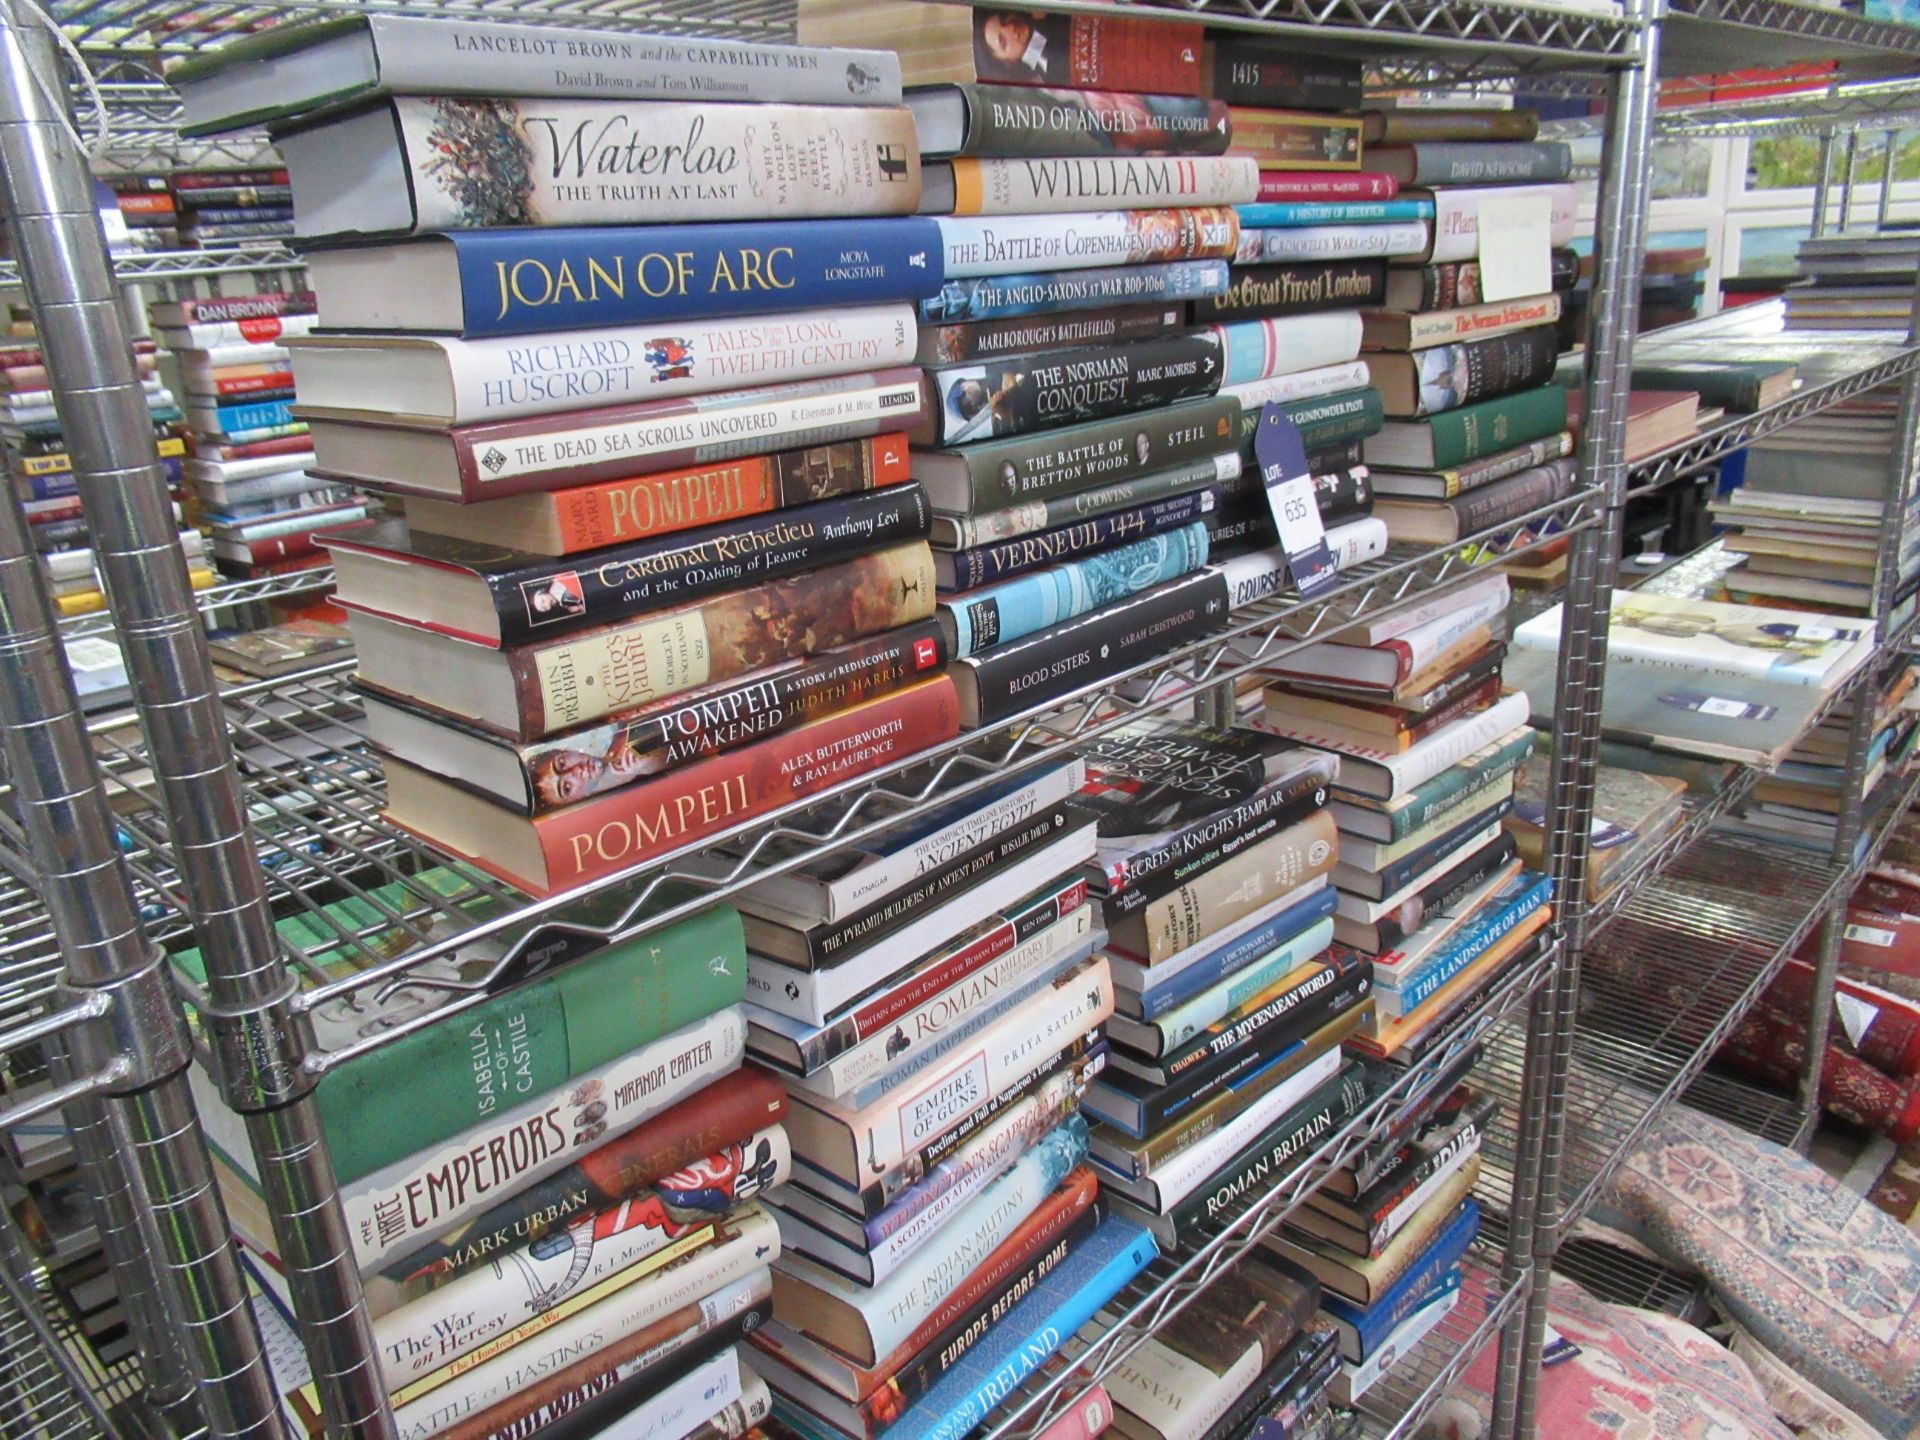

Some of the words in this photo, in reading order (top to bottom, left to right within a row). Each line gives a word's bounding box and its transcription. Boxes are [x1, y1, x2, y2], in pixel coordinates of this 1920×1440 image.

[454, 34, 557, 57] LANCELOT
[567, 41, 632, 60] BROWN
[640, 47, 662, 61] and
[665, 47, 682, 62] the
[688, 49, 781, 68] CAPABILITY
[785, 54, 818, 69] MEN
[555, 71, 590, 87] David
[593, 72, 633, 89] Brown
[636, 75, 656, 89] and
[660, 76, 685, 91] Tom
[688, 76, 748, 93] Williamson
[993, 104, 1045, 129] BAND
[1050, 107, 1071, 130] OF
[1077, 107, 1137, 133] ANGELS
[1145, 114, 1168, 130] KATE
[1171, 115, 1209, 133] COOPER
[521, 115, 739, 178] Waterloo
[1026, 159, 1172, 198] WILLIAM
[1178, 163, 1197, 194] II
[1451, 162, 1485, 176] DAVID
[1488, 162, 1533, 176] NEWSOME
[554, 185, 592, 200] THE
[598, 185, 662, 200] TRUTH
[667, 185, 693, 199] AT
[697, 184, 738, 199] LAST
[840, 251, 869, 264] MOYA
[951, 244, 978, 264] THE
[983, 230, 1042, 261] BATTLE
[1045, 242, 1060, 257] OF
[1065, 229, 1145, 256] COPENHAGEN
[495, 256, 626, 320] JOAN
[637, 252, 694, 298] OF
[709, 247, 795, 291] ARC
[825, 265, 885, 280] LONGSTAFFE
[980, 289, 1002, 307] THE
[1006, 281, 1087, 304] ANGLO-SAXONS
[1089, 284, 1098, 297] AT
[1101, 280, 1122, 295] WAR
[1125, 276, 1164, 295] 800-1066
[197, 302, 228, 322] DAN
[229, 301, 279, 321] BROWN
[702, 328, 761, 352] TALES
[785, 321, 842, 344] LONG
[895, 319, 903, 346] Yale
[510, 340, 630, 374] RICHARD
[707, 350, 796, 377] TWELFTH
[801, 338, 882, 366] CENTURY
[1032, 369, 1062, 387] THE
[1067, 357, 1129, 381] NORMAN
[1137, 369, 1163, 383] MARC
[1165, 361, 1196, 379] MORRIS
[483, 367, 634, 407] HUSCROFT
[879, 392, 914, 407] ELEMENT
[1037, 379, 1129, 414] CONQUEST
[516, 447, 546, 465] THE
[555, 439, 597, 460] DEAD
[605, 435, 631, 455] SEA
[638, 426, 694, 449] SCROLLS
[700, 413, 777, 439] UNCOVERED
[1026, 456, 1052, 471] THE
[1058, 444, 1104, 465] BATTLE
[1109, 438, 1124, 452] OF
[1168, 426, 1205, 446] STEIL
[1022, 467, 1081, 490] BRETTON
[1087, 456, 1129, 475] WOODS
[607, 467, 746, 537] POMPEII
[1284, 498, 1307, 522] 635
[823, 514, 874, 542] Anthony
[879, 509, 899, 531] Levi
[990, 522, 1106, 573] VERNEUIL
[1110, 512, 1146, 538] 1424
[599, 543, 709, 588] Cardinal
[716, 523, 814, 562] Richelieu
[623, 584, 649, 602] and
[655, 577, 679, 595] the
[685, 564, 741, 586] Making
[747, 556, 760, 572] of
[766, 547, 808, 570] France
[1120, 629, 1147, 648] SARAH
[1149, 609, 1195, 636] GRISTWOOD
[786, 683, 792, 692] A
[795, 672, 826, 690] STORY
[828, 667, 837, 679] of
[839, 648, 900, 674] REDISCOVERY
[1010, 668, 1048, 695] BLOOD
[1051, 650, 1090, 677] SISTERS
[659, 680, 780, 742] POMPEII
[666, 709, 782, 762] AWAKENED
[781, 751, 812, 774] ALEX
[817, 718, 903, 760] BUTTERWORTH
[792, 774, 802, 786] &
[805, 764, 829, 784] RAY
[833, 740, 894, 772] LAURENCE
[569, 775, 749, 874] POMPEII
[1236, 790, 1284, 826] TEMPLAR
[1170, 848, 1182, 860] THE
[1172, 840, 1180, 850] OF
[1182, 819, 1234, 854] KNIGHTS
[1123, 850, 1170, 882] SECRETS
[822, 935, 843, 952] THE
[844, 912, 882, 946] PYRAMID
[884, 891, 924, 927] BUILDERS
[926, 885, 936, 900] OF
[938, 865, 969, 893] ANCIENT
[972, 852, 996, 877] EGYPT
[1001, 837, 1027, 862] ROSALIE
[1029, 823, 1049, 844] DAVID
[1415, 976, 1439, 1000] THE
[1440, 926, 1501, 976] LANDSCAPE
[1501, 913, 1516, 932] OF
[1517, 892, 1540, 918] MAN
[1210, 1031, 1235, 1055] THE
[1236, 992, 1299, 1042] MYCENAEAN
[1298, 969, 1335, 1001] WORLD
[508, 1013, 532, 1093] CASTILE
[1004, 1036, 1042, 1066] PRIYA
[1047, 1006, 1083, 1036] SATIA
[469, 1022, 496, 1116] ISABELLA
[498, 1052, 508, 1069] OF
[613, 1066, 666, 1110] MIRANDA
[670, 1040, 712, 1079] CARTER
[1170, 1047, 1209, 1075] CHADWICK
[913, 1120, 934, 1139] OF
[937, 1085, 979, 1125] GUNS
[915, 1069, 974, 1121] EMPIRE
[927, 1130, 957, 1158] Decline
[959, 1118, 974, 1137] and
[975, 1107, 990, 1124] Fall
[991, 1100, 999, 1114] of
[1001, 1073, 1037, 1105] Napoleon's
[1038, 1052, 1062, 1079] Empire
[405, 1106, 566, 1228] EMPERORS
[1206, 1158, 1269, 1216] ROMAN
[1272, 1108, 1332, 1163] BRITAIN
[360, 1221, 374, 1246] THE
[442, 1234, 508, 1273] MARK
[513, 1190, 589, 1236] URBAN
[940, 1319, 989, 1371] EUROPE
[991, 1274, 1036, 1323] BEFORE
[1037, 1239, 1068, 1280] ROME
[386, 1334, 432, 1364] The
[433, 1309, 475, 1343] War
[413, 1351, 434, 1370] on
[440, 1312, 508, 1355] Heresy
[977, 1327, 1059, 1414] IRELAND
